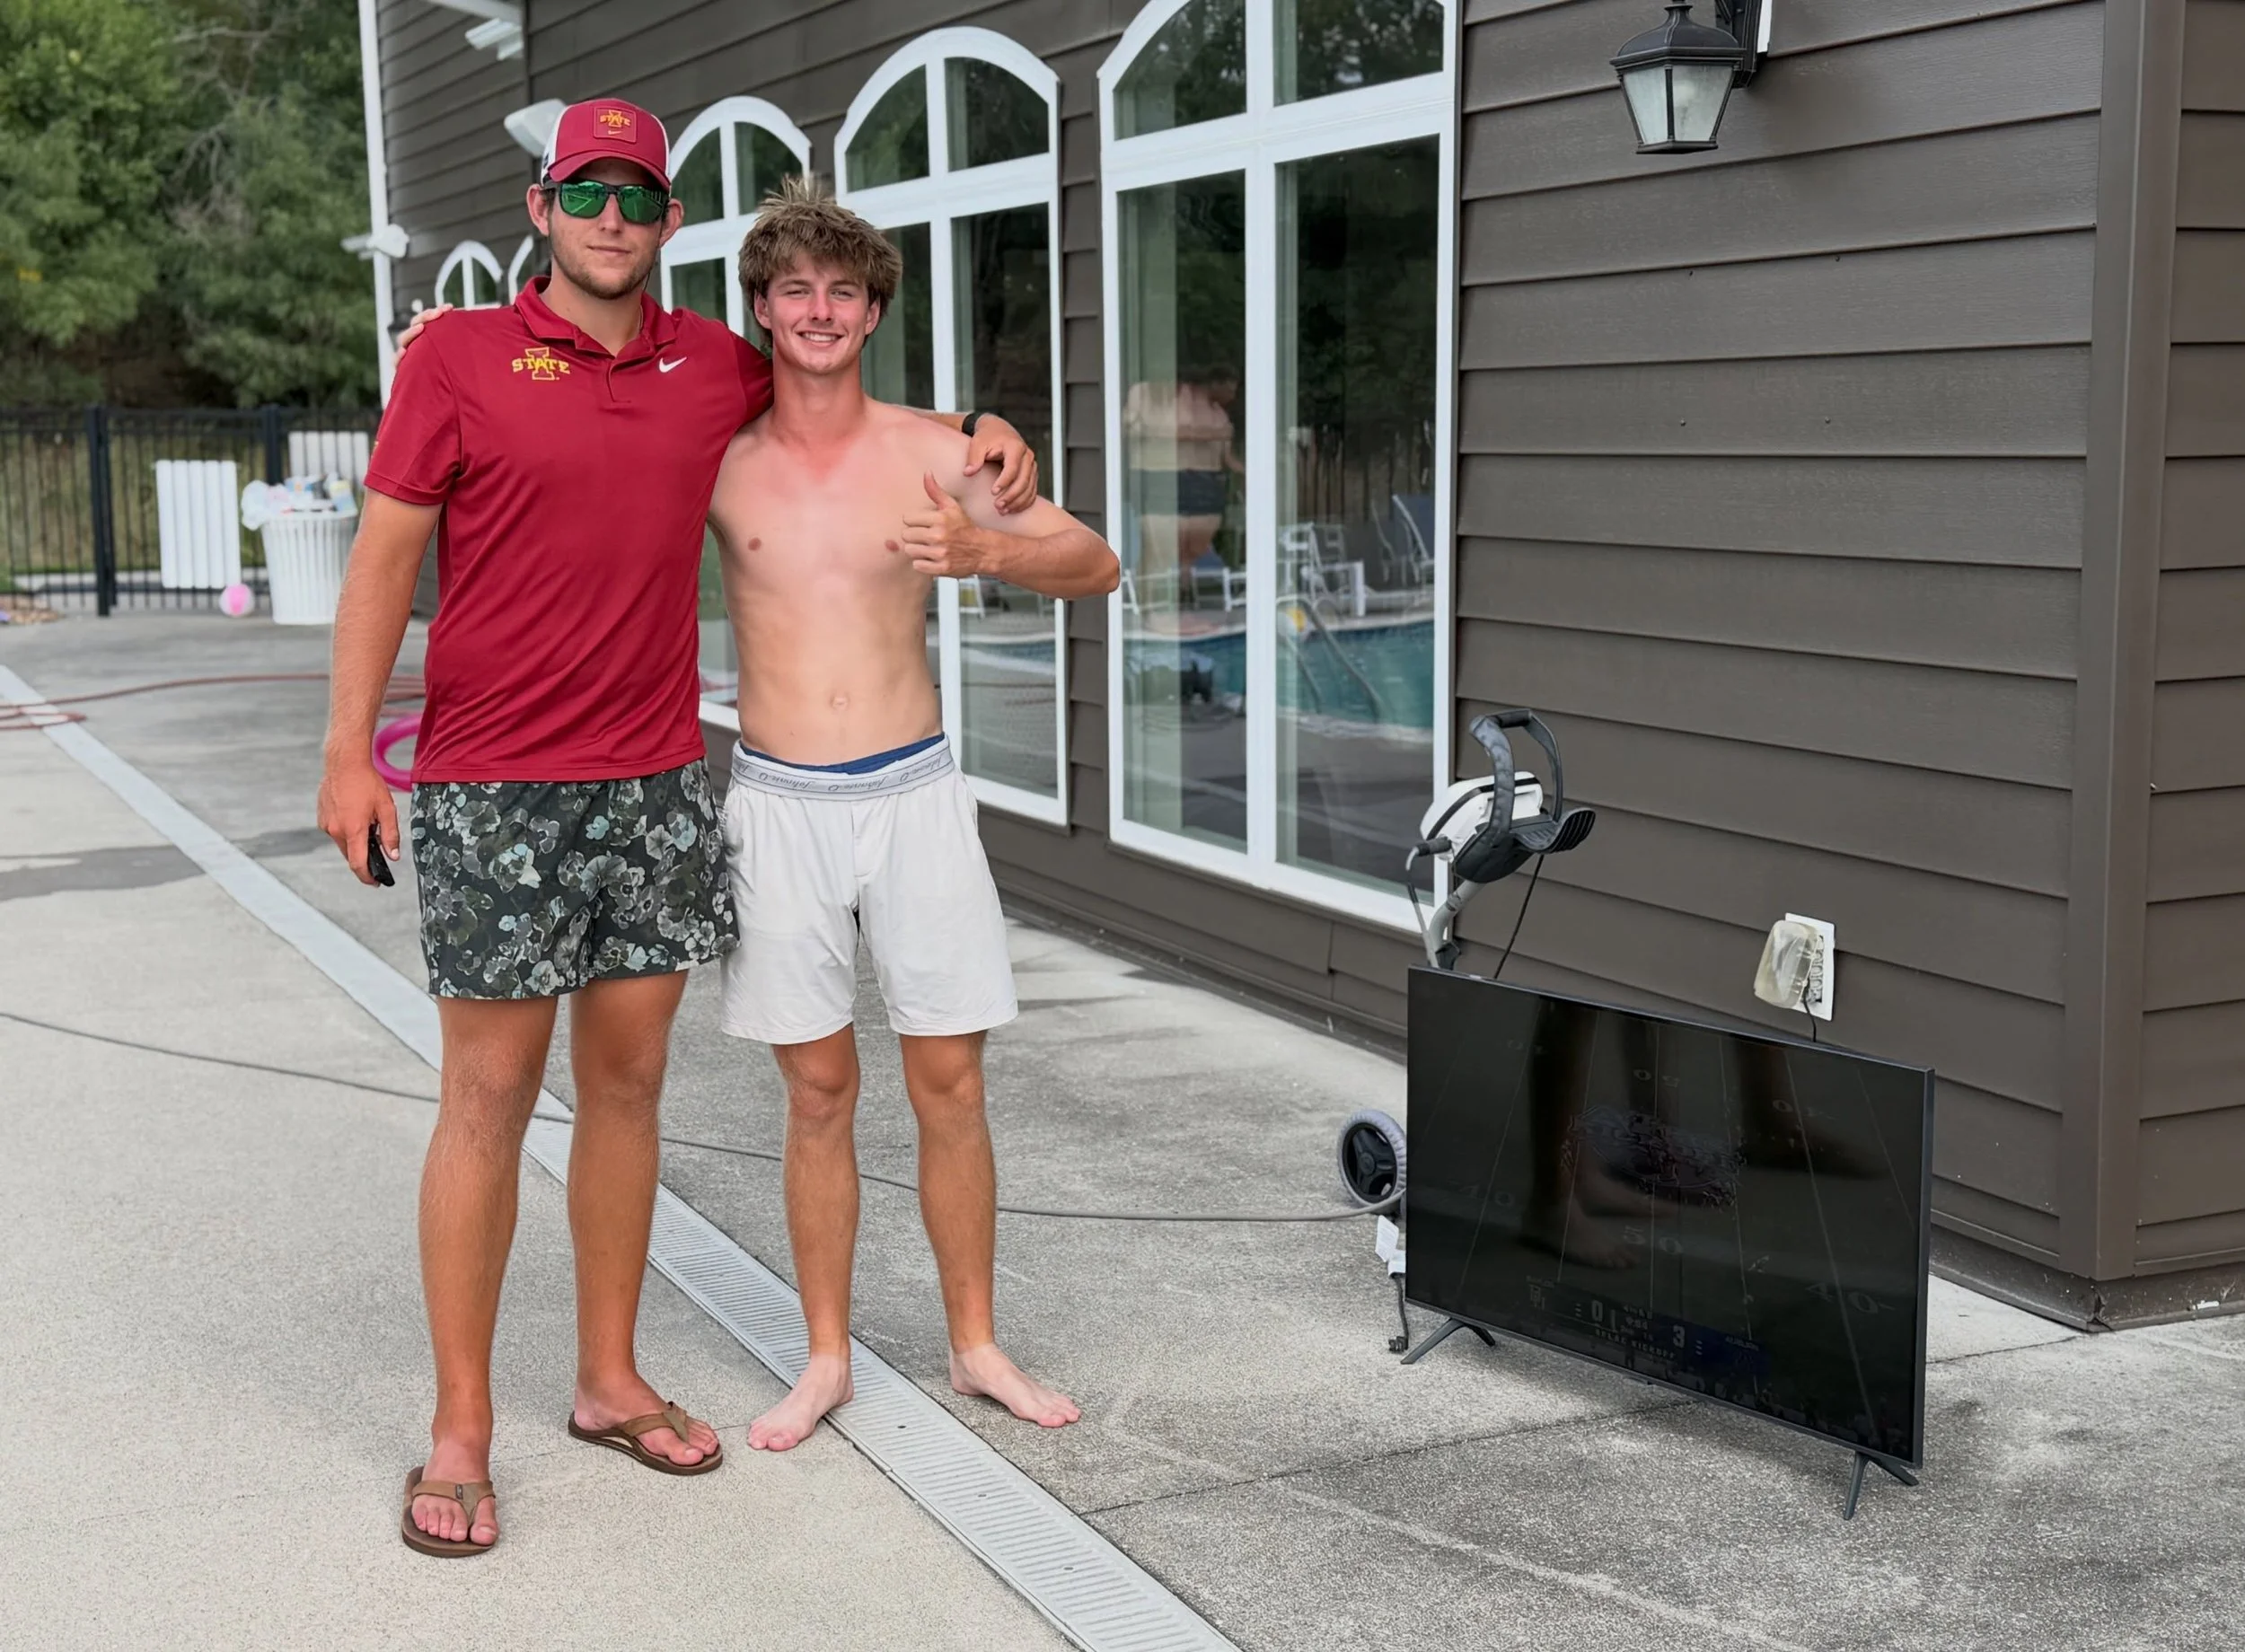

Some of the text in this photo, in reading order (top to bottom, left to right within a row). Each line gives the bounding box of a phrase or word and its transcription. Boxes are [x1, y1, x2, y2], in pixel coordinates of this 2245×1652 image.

[600, 113, 631, 127] STATE
[511, 356, 571, 376] STATE
[1672, 1323, 1686, 1349] 3
